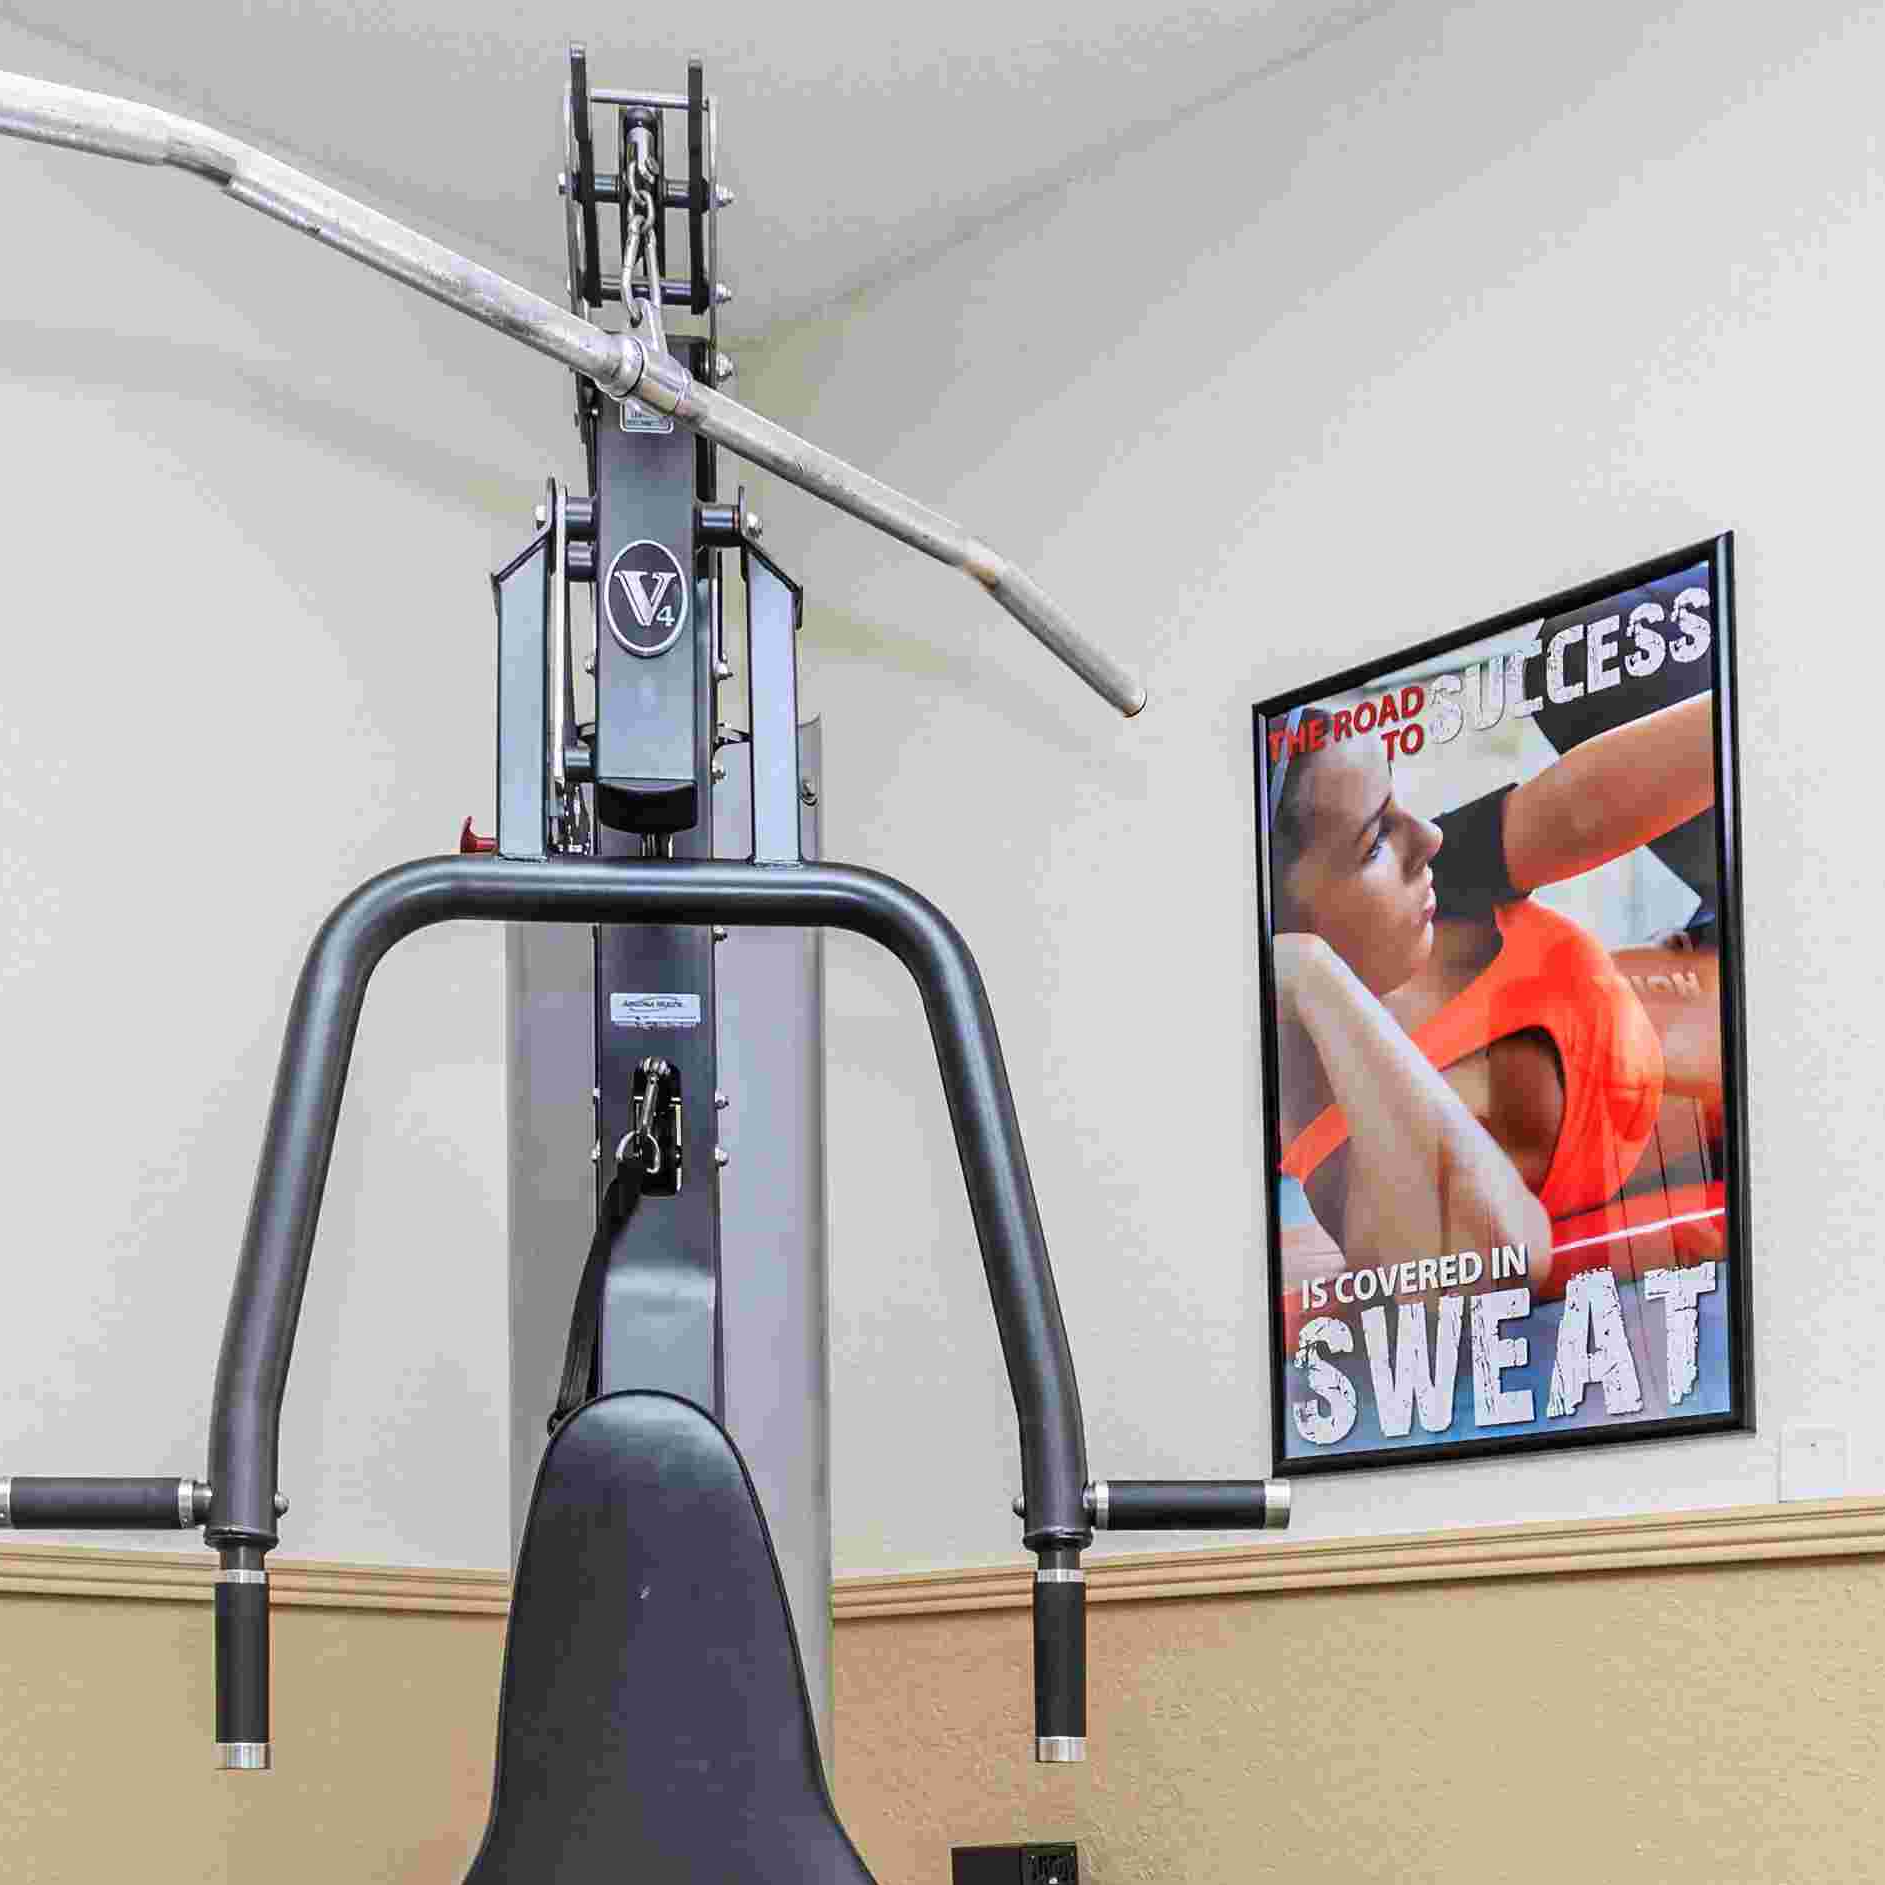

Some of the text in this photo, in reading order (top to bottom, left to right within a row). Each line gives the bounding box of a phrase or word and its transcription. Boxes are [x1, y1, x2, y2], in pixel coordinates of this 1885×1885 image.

[1428, 587, 1713, 745] SUCCESS
[1267, 686, 1426, 763] THE ROAD
[1380, 724, 1426, 762] TO
[1301, 1243, 1529, 1310] IS COVERED IN
[1292, 1261, 1718, 1446] SWEAT
